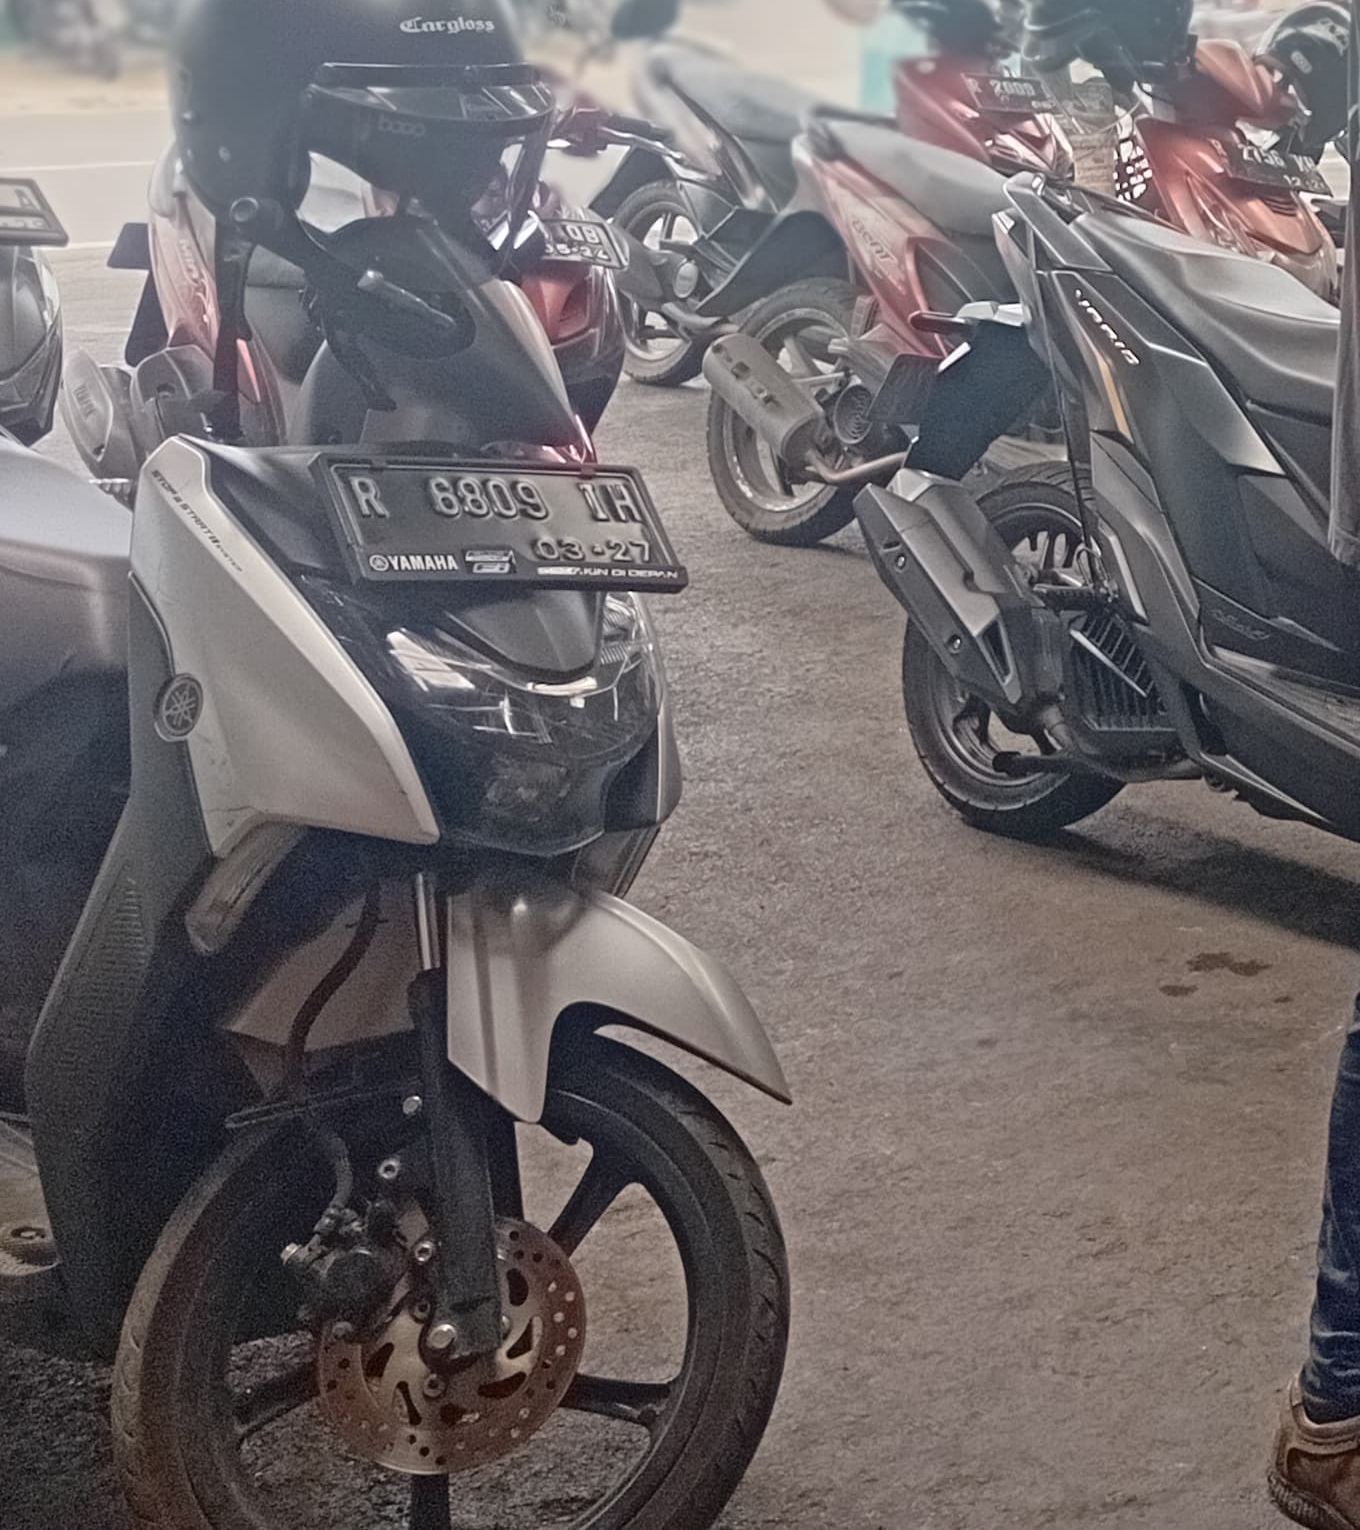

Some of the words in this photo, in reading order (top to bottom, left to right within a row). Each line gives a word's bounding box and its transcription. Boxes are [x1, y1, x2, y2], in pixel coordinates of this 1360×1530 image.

[400, 17, 495, 34] Cargloss
[350, 475, 389, 519] R
[428, 476, 549, 521] 6809
[386, 554, 459, 571] YAMAHA
[611, 568, 627, 577] DI
